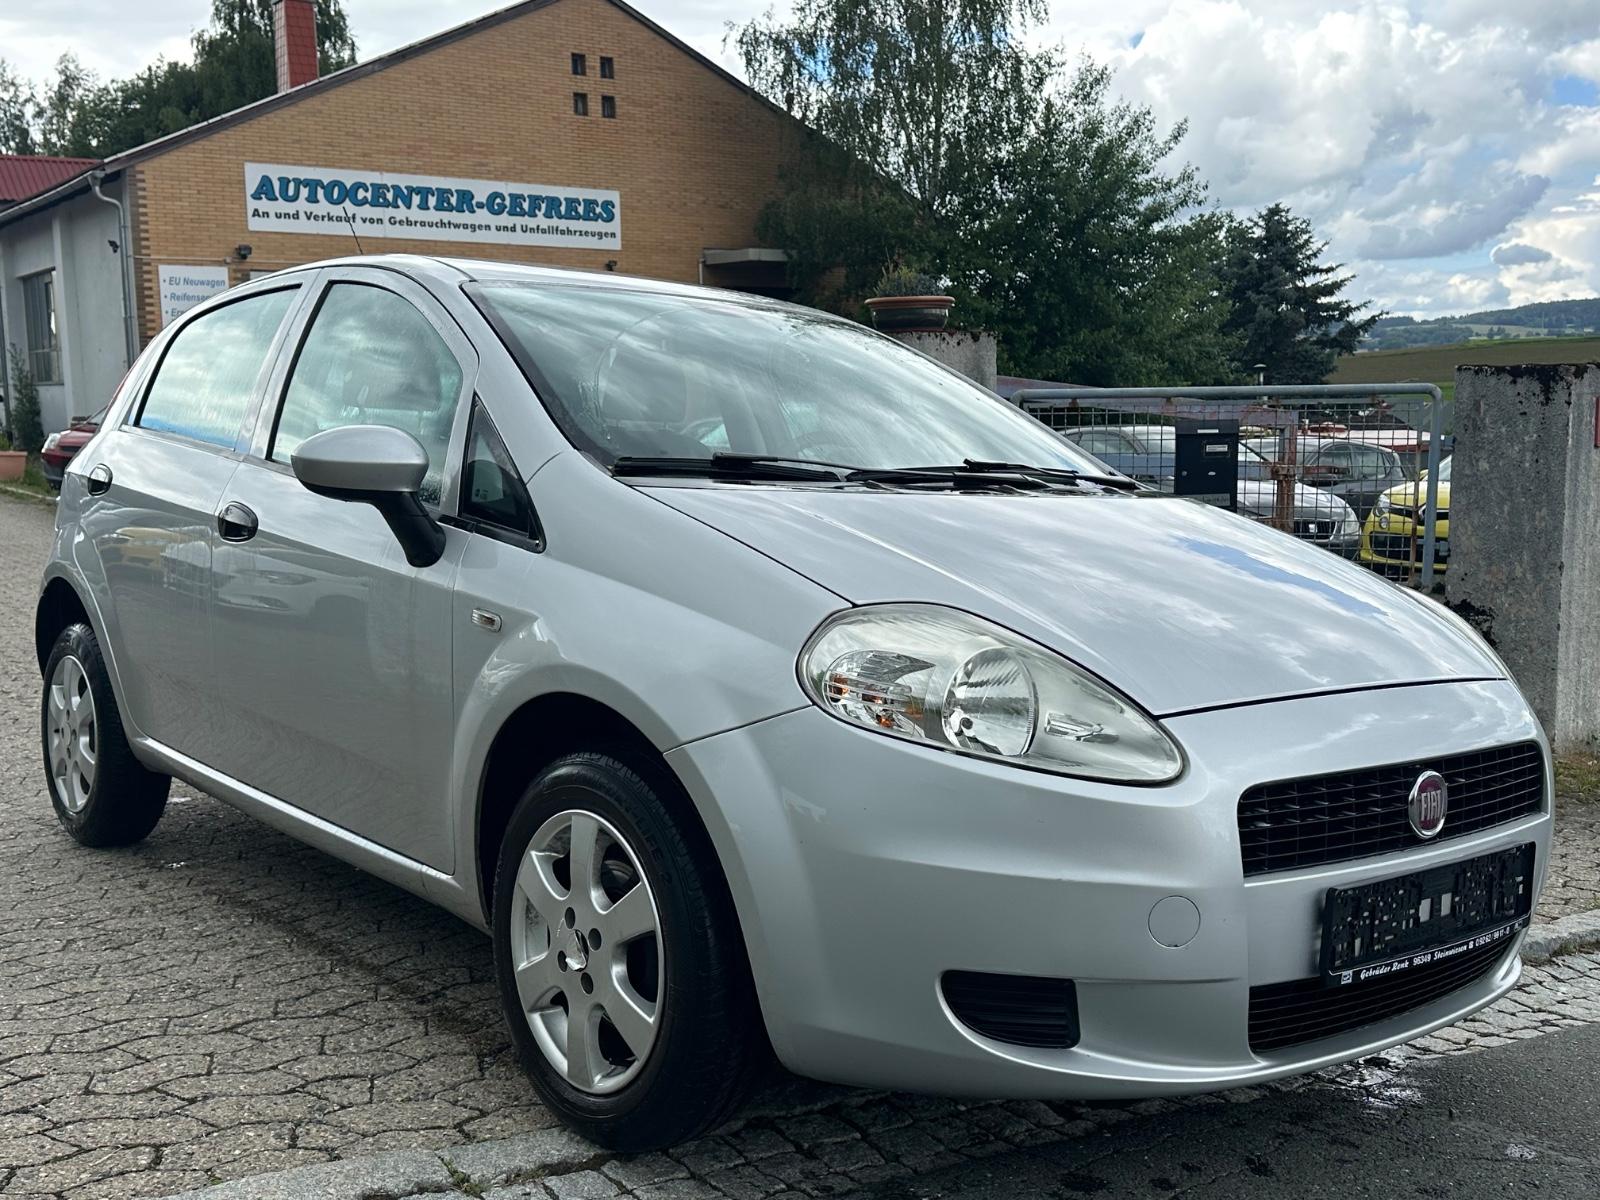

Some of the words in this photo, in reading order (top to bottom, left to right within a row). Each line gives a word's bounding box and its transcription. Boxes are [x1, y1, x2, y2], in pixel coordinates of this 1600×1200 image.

[251, 175, 616, 223] AUTOCENTER-GEFREES
[251, 208, 270, 219] An
[274, 209, 300, 221] und
[304, 211, 357, 224] Verkauf
[360, 216, 384, 225] von
[388, 216, 492, 233] Gebrauchtwagen
[495, 223, 517, 233] und
[520, 224, 617, 240] Unfallfahrzeugen
[168, 276, 182, 286] EU
[183, 277, 226, 288] Neuwagen
[1420, 789, 1442, 821] FIAT
